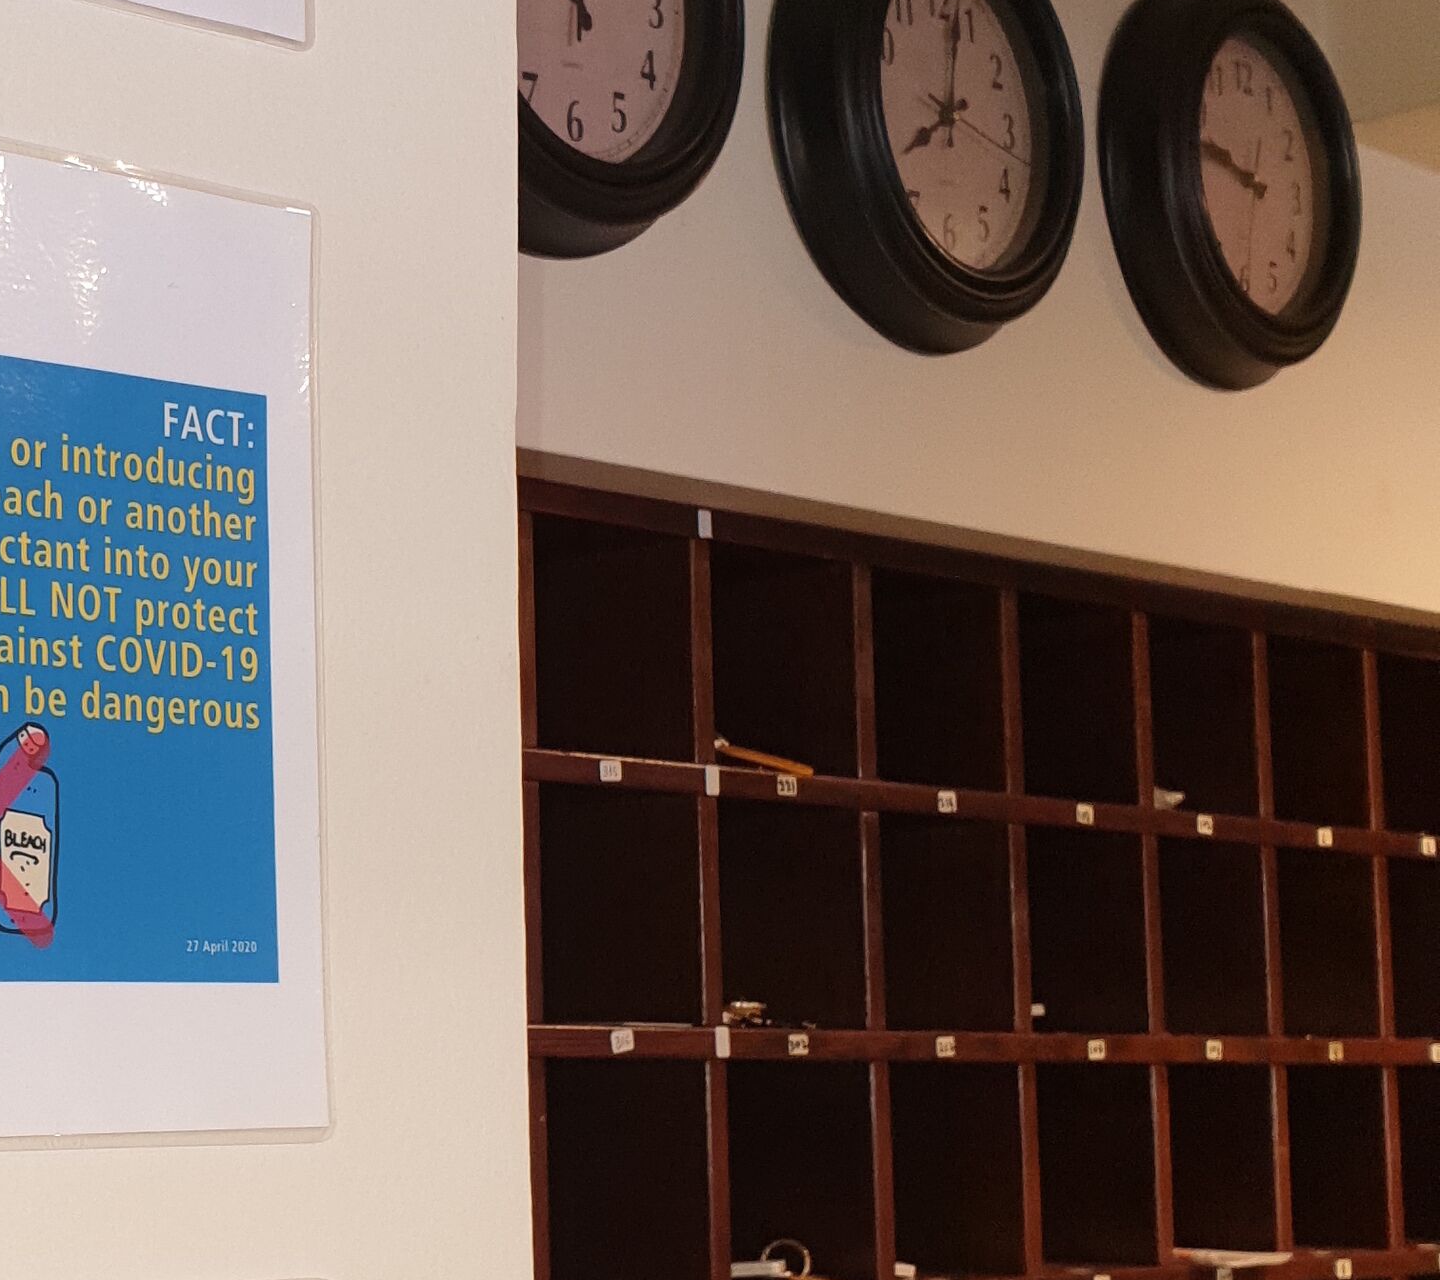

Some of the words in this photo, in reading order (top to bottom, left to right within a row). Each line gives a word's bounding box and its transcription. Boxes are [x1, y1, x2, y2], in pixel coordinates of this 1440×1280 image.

[964, 7, 975, 44] 1
[640, 49, 657, 91] 4
[989, 53, 1003, 91] 2
[566, 99, 585, 143] 6
[611, 92, 627, 134] 5
[998, 168, 1011, 204] 4
[977, 205, 991, 242] 5
[163, 402, 255, 450] FACT:
[11, 438, 46, 468] or
[62, 433, 253, 503] introducing
[78, 496, 112, 525] or
[126, 500, 256, 539] another
[105, 536, 169, 579] into
[183, 556, 257, 592] your
[52, 581, 121, 623] NOT
[136, 599, 257, 635] protect
[97, 635, 256, 681] COVID-19
[25, 675, 66, 716] be
[82, 680, 259, 733] dangerous
[4, 828, 47, 853] BLEACH
[186, 940, 199, 953] 27
[203, 939, 229, 954] April
[232, 940, 257, 953] 2020
